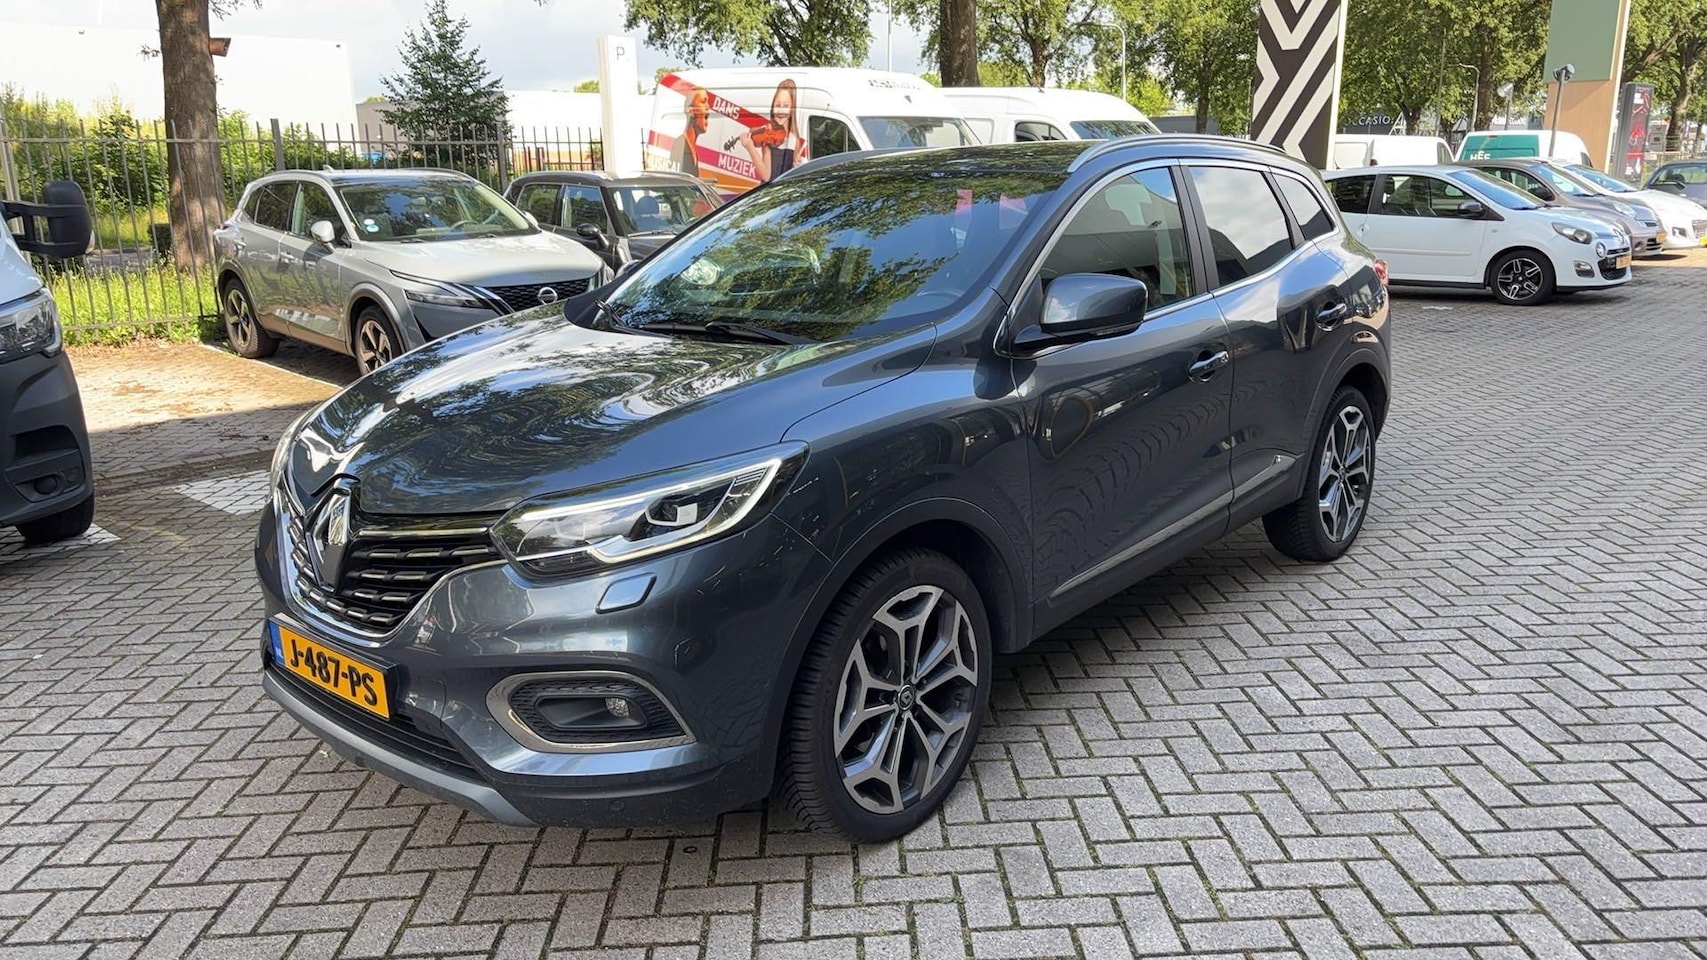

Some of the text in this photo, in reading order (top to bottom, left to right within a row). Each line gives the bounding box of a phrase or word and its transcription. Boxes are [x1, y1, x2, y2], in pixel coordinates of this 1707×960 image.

[712, 97, 740, 120] DANS
[718, 153, 756, 178] MUZIEK
[290, 639, 378, 706] J-487-PS
